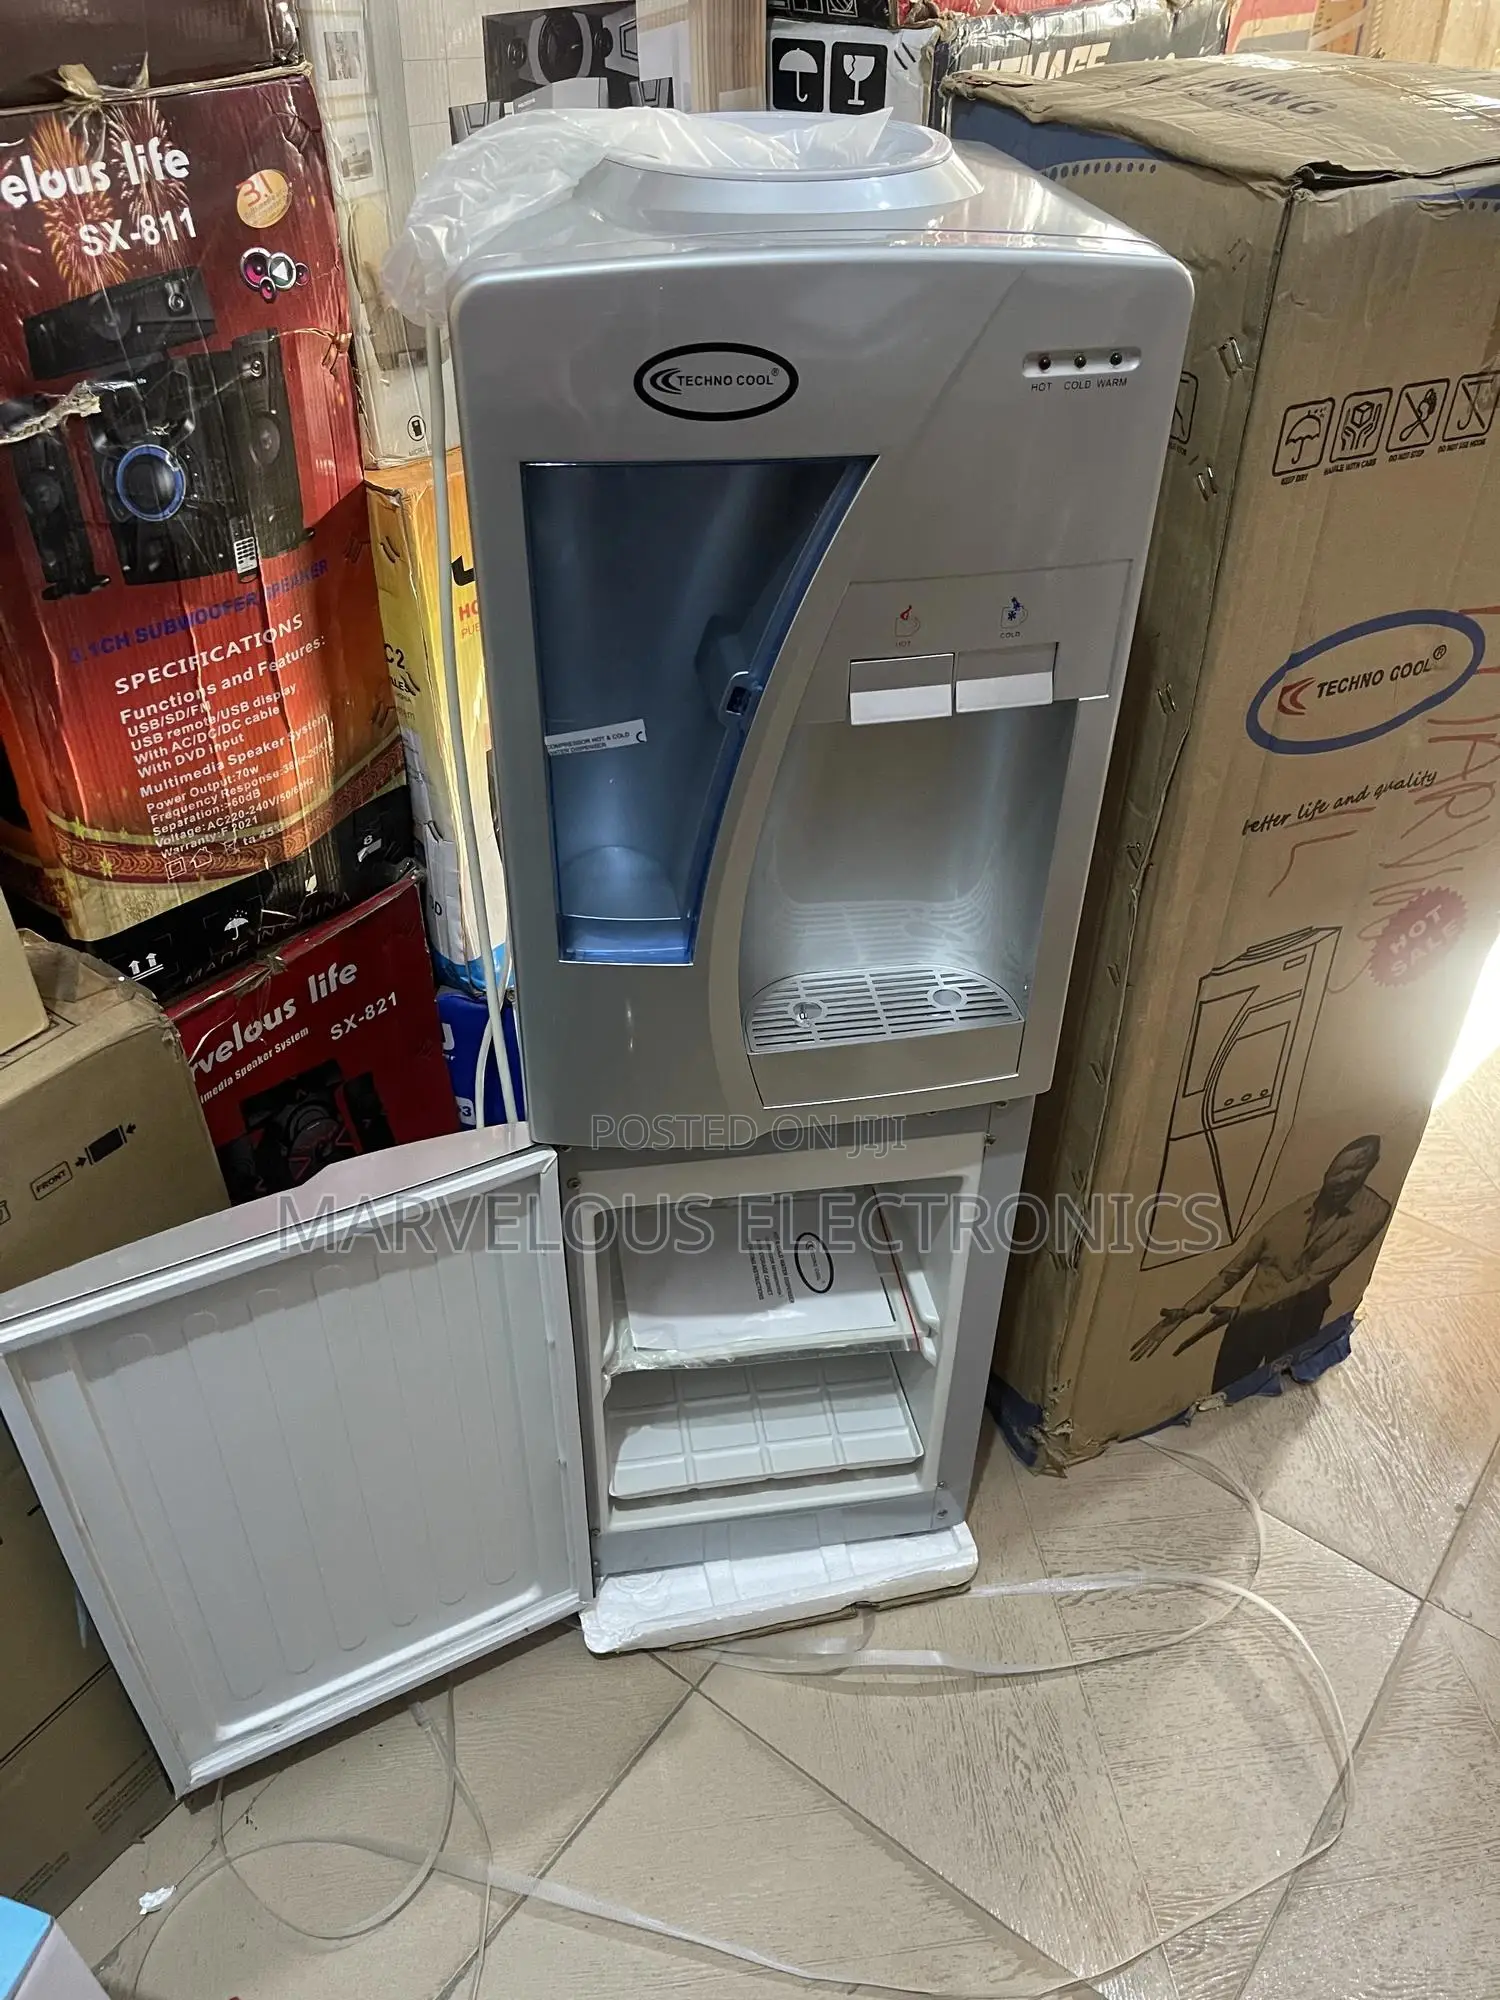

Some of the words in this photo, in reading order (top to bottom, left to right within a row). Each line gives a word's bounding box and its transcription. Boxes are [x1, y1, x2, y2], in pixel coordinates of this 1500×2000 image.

[120, 136, 191, 185] life
[79, 206, 197, 258] SX-811
[676, 374, 733, 386] TECHNO
[736, 374, 774, 386] COOL
[1031, 382, 1053, 392] HOT
[1063, 379, 1091, 391] COLD
[1096, 377, 1128, 388] WARM
[134, 590, 261, 645] SUBWOOFER
[264, 558, 328, 599] SPEAKER
[114, 613, 304, 695] SPECIFICATIONS
[1000, 631, 1021, 639] COLD
[119, 686, 217, 725] Functions
[221, 665, 254, 691] and
[258, 634, 326, 677] Features:
[1317, 669, 1385, 699] TECHNO
[1390, 658, 1434, 682] COOL
[127, 700, 212, 738] USB/SD/FM
[130, 730, 164, 752] USB
[167, 700, 251, 741] remote/USB
[252, 682, 298, 708] display
[133, 744, 169, 766] With
[171, 716, 242, 753] AC/DC/DC
[244, 705, 281, 726] cable
[612, 731, 630, 739] COLD
[137, 760, 173, 780] With
[175, 745, 206, 767] DVD
[208, 732, 246, 756] input
[139, 758, 225, 799] Multimedia
[227, 736, 286, 768] Speaker
[146, 793, 187, 814] Power
[189, 764, 260, 798] Output:70w
[150, 793, 218, 825] Frequency
[1241, 812, 1292, 836] better
[1297, 798, 1331, 822] life
[1333, 785, 1371, 810] and
[1374, 770, 1438, 799] quality
[1389, 903, 1443, 955] HOT
[1390, 919, 1459, 977] SALE
[307, 962, 358, 1004] life
[330, 991, 397, 1041] SX-821
[234, 1047, 274, 1081] Speaker
[274, 1026, 310, 1055] System
[35, 1168, 68, 1193] FRONT
